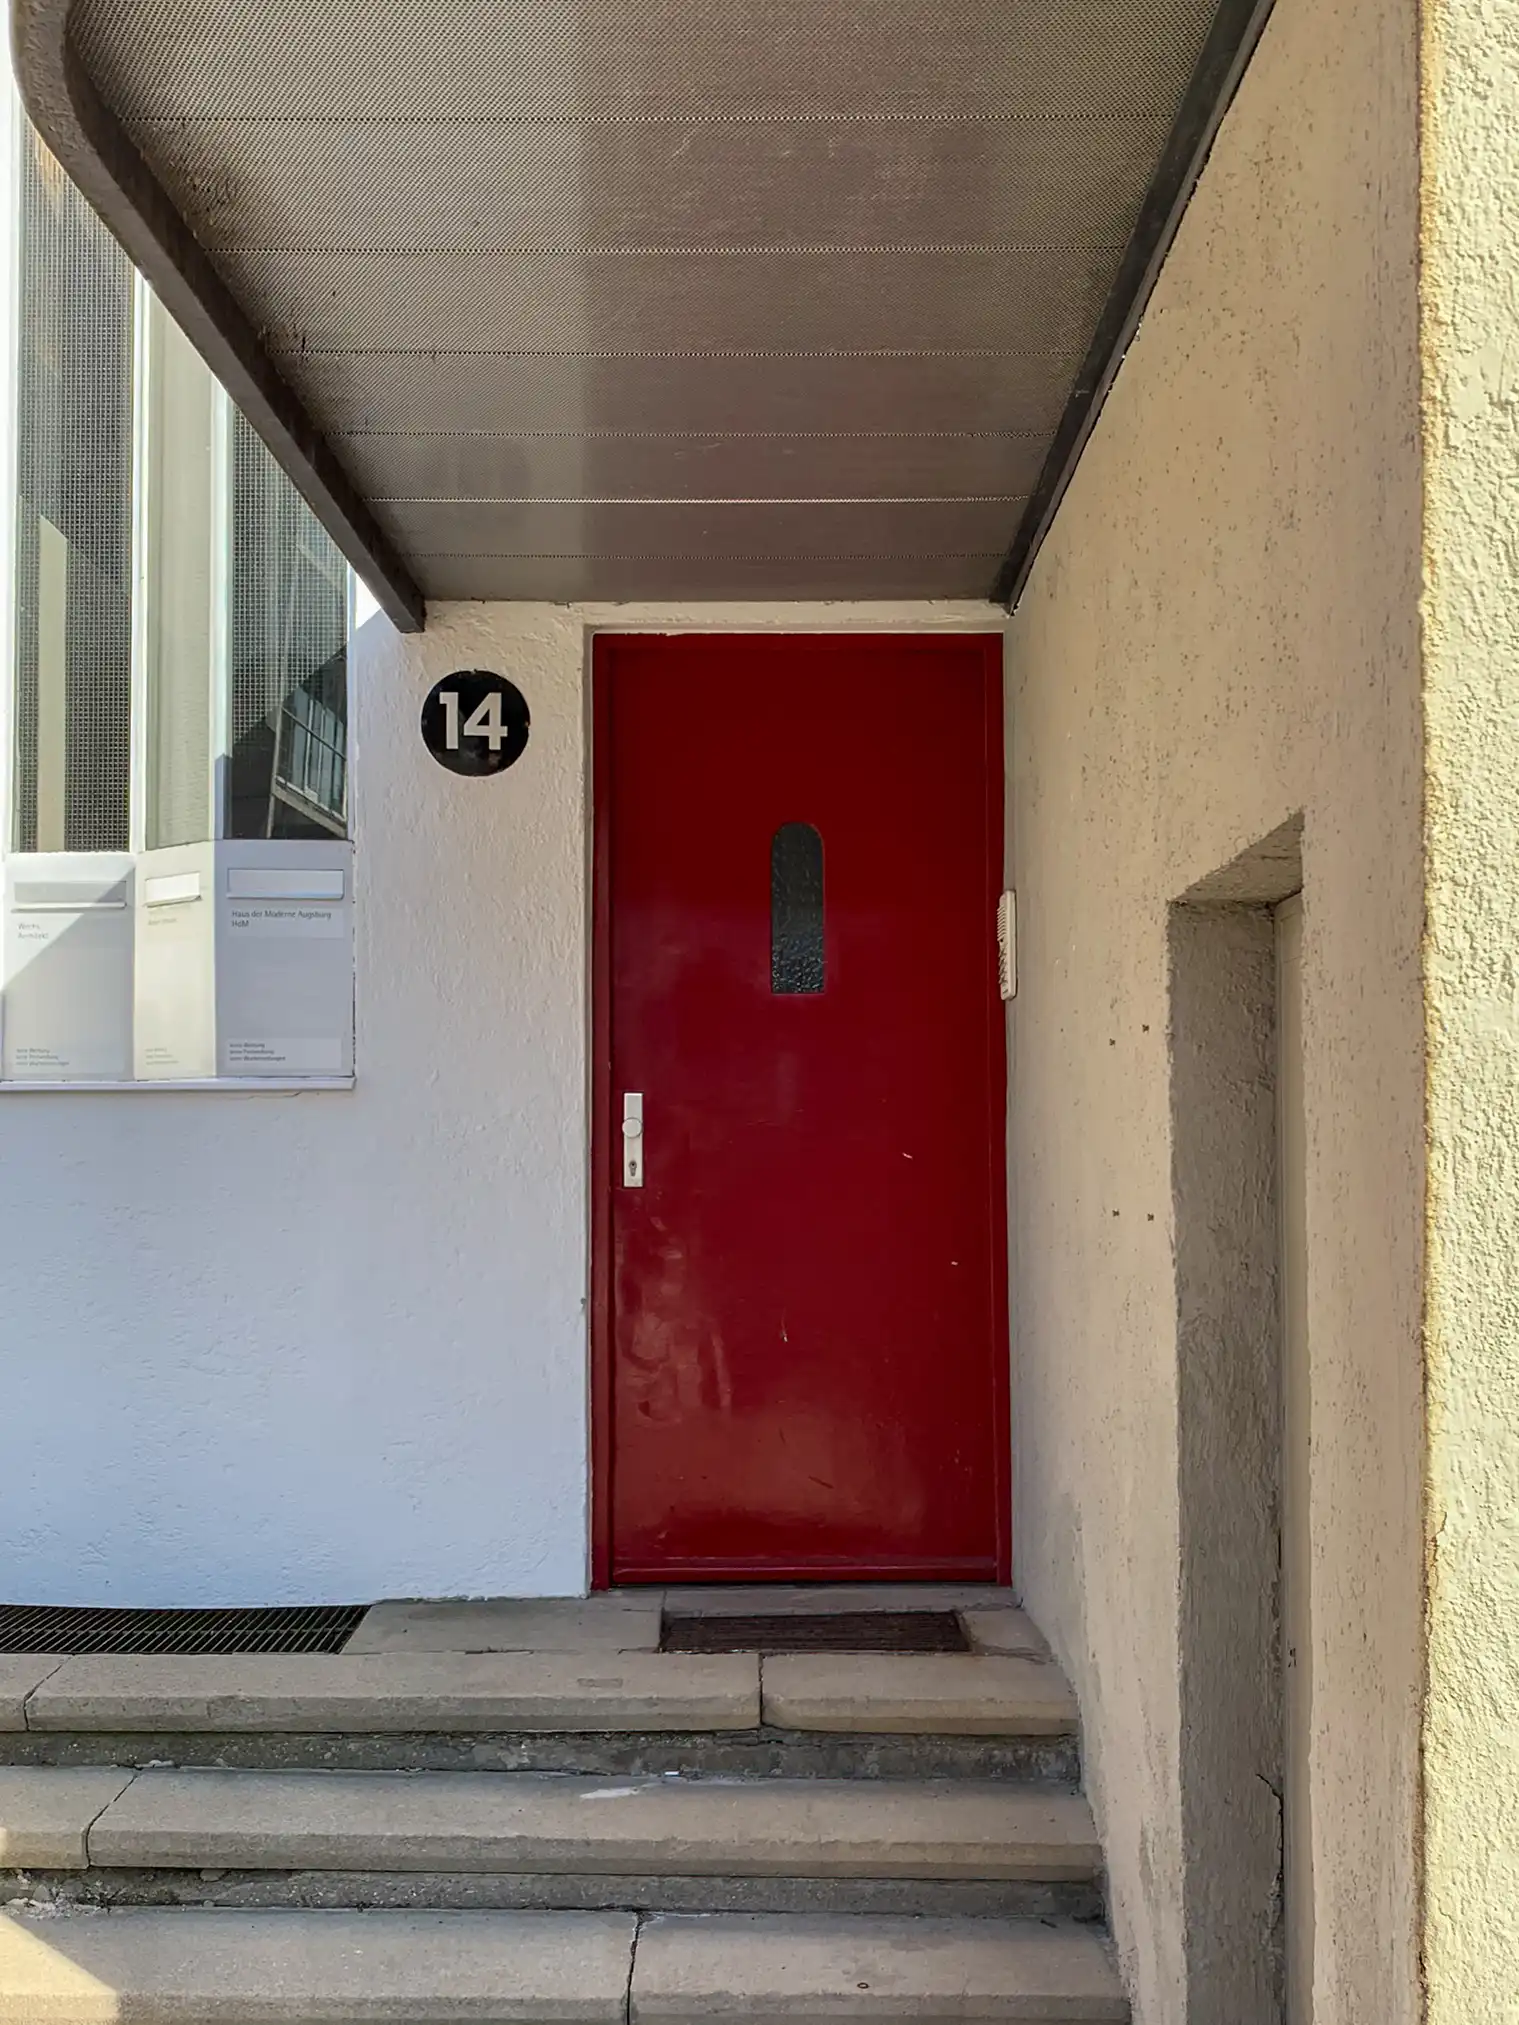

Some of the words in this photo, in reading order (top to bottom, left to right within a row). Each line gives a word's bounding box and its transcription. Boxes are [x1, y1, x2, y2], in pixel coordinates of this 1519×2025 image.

[439, 692, 508, 750] 14
[232, 910, 250, 918] Haus
[264, 910, 296, 918] Moderne
[298, 910, 332, 920] Augsburg
